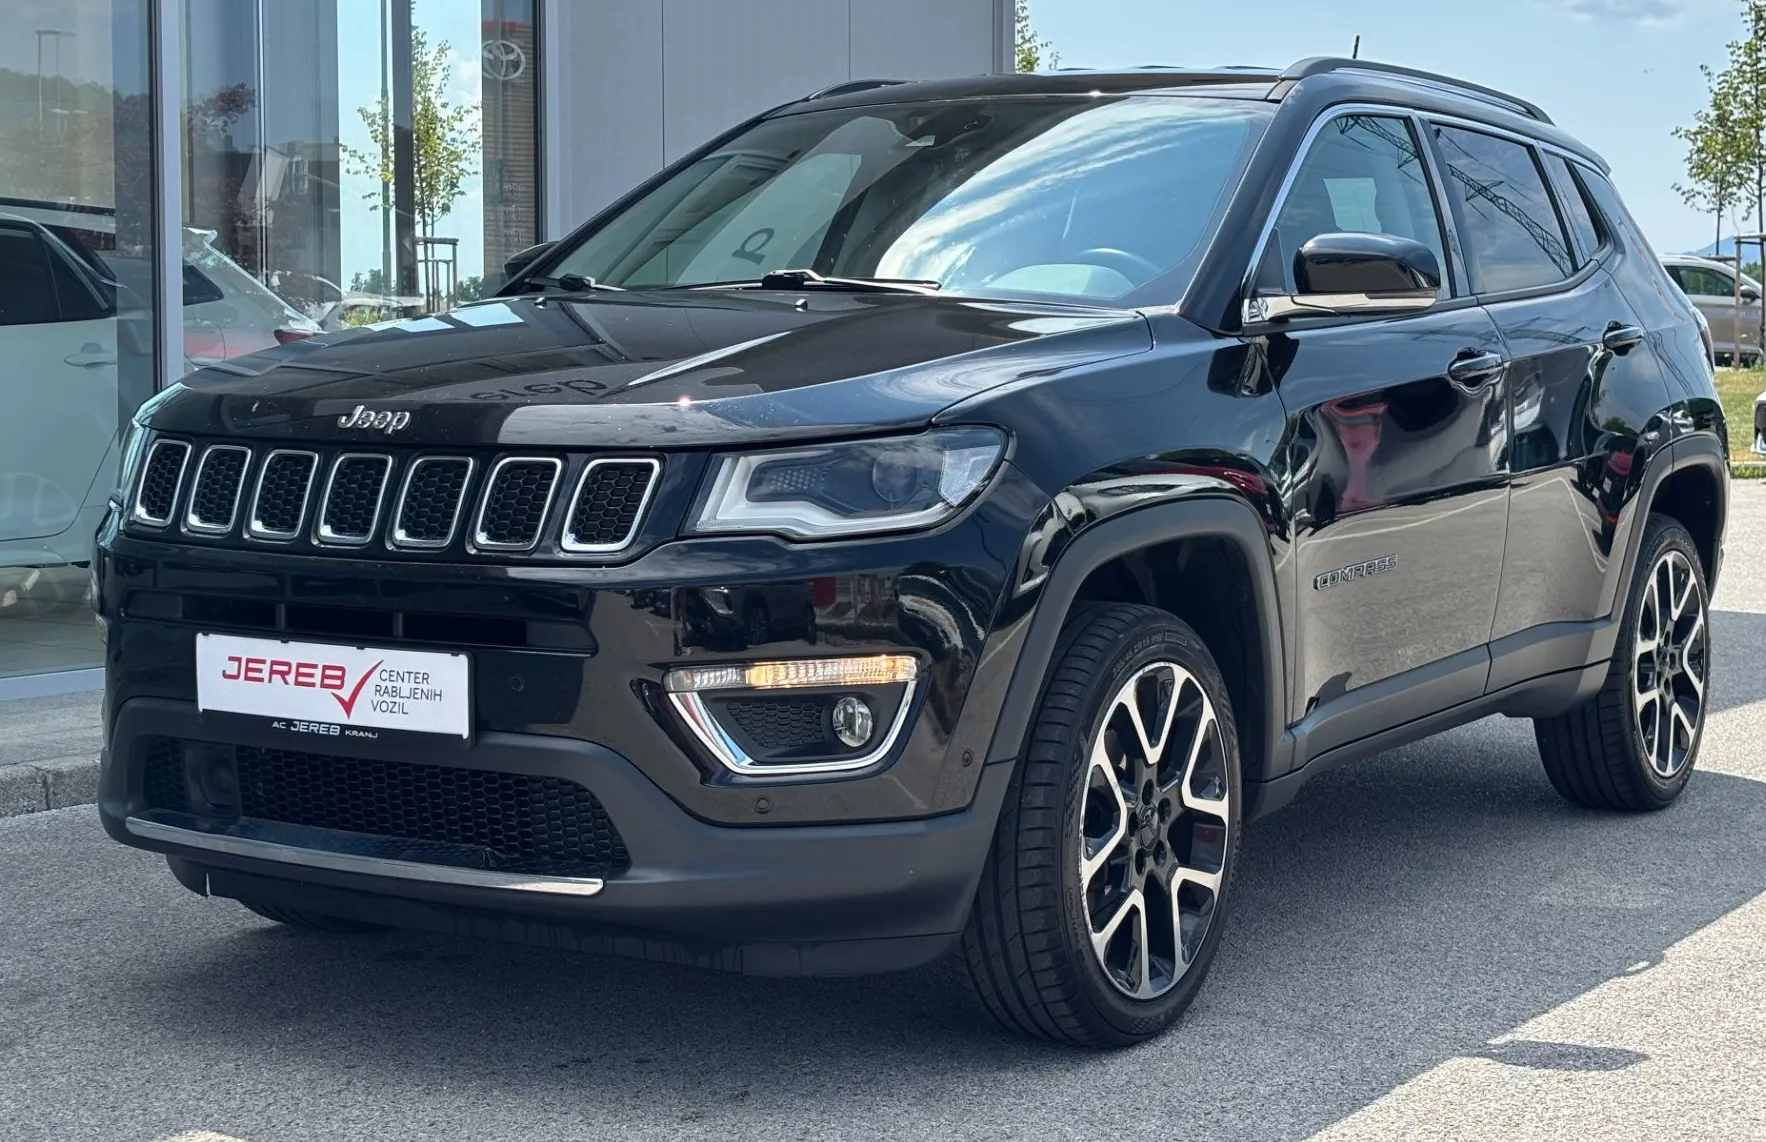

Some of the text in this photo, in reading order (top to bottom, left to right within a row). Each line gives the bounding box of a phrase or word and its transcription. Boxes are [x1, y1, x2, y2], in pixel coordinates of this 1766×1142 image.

[337, 404, 411, 435] Jeep
[1313, 553, 1398, 591] COMPASS
[221, 655, 347, 691] JEREB
[379, 669, 430, 685] CENTER
[374, 684, 443, 702] RABLJENIH
[370, 699, 409, 715] VOZIL
[271, 720, 379, 739] AC JEREB KRANJ
